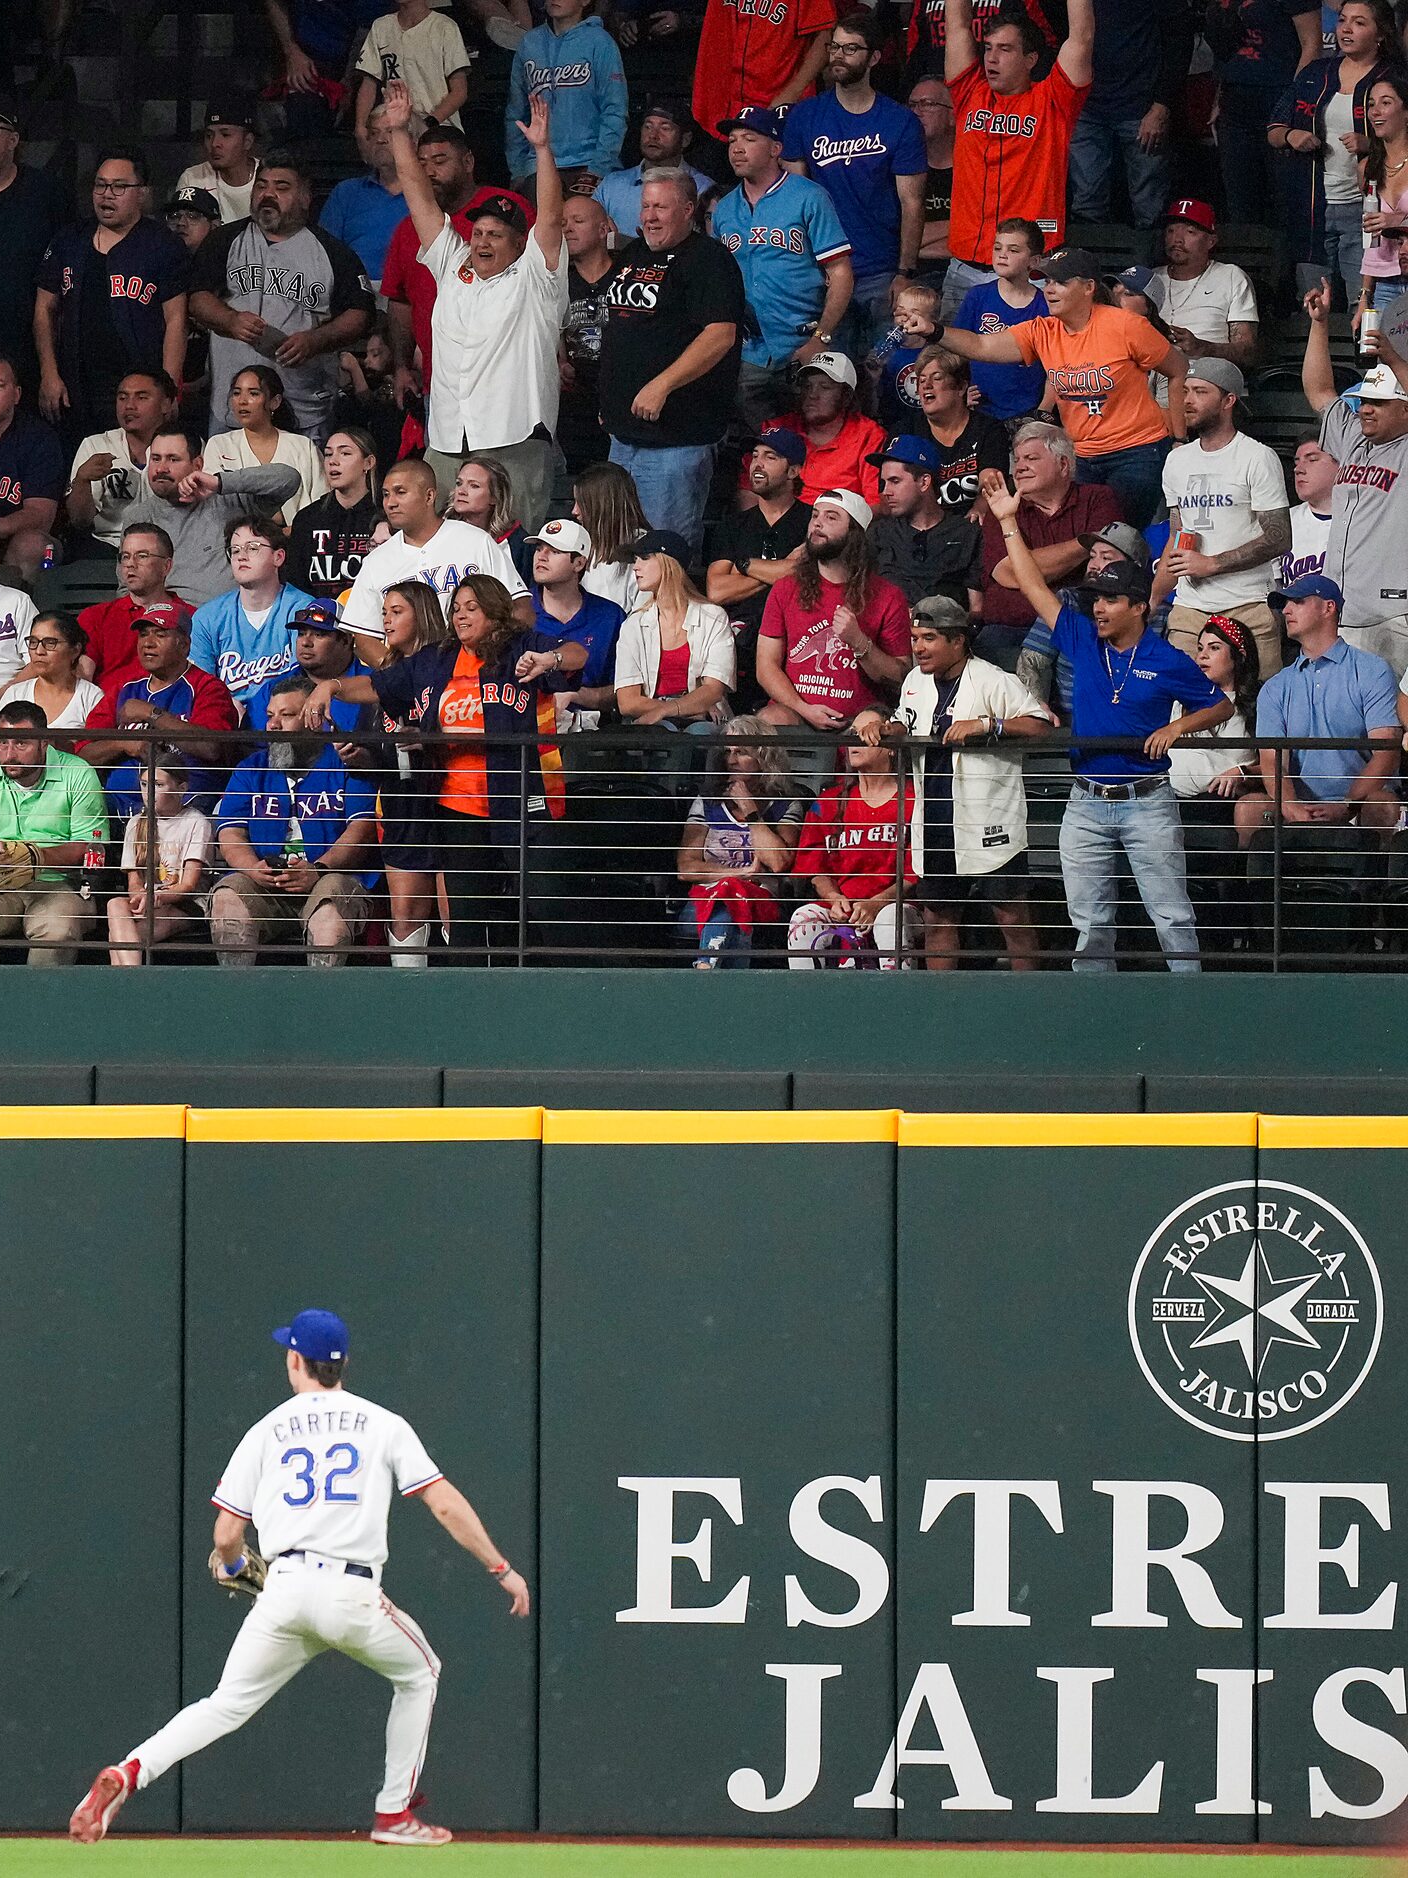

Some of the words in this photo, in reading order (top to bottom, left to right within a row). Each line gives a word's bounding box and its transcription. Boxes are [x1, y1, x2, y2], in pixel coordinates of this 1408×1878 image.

[524, 59, 591, 92] Rangers
[738, 106, 753, 119] T
[775, 105, 789, 120] T
[811, 133, 887, 168] Rangers
[1178, 200, 1192, 214] T
[227, 263, 326, 310] TEXAS
[605, 280, 660, 310] ALCS
[1087, 400, 1102, 416] H
[1176, 493, 1234, 510] RANGERS
[312, 529, 332, 554] T
[807, 619, 830, 635] TOUR
[838, 655, 858, 670] '96
[798, 673, 835, 687] ORIGINAL
[829, 688, 854, 699] SHOW
[1162, 1202, 1347, 1280] ESTRELLA
[1152, 1302, 1205, 1318] CERVEZA
[1307, 1303, 1356, 1319] DORADA
[1178, 1368, 1328, 1420] JALISCO
[273, 1410, 369, 1444] CARTER
[280, 1441, 362, 1510] 32
